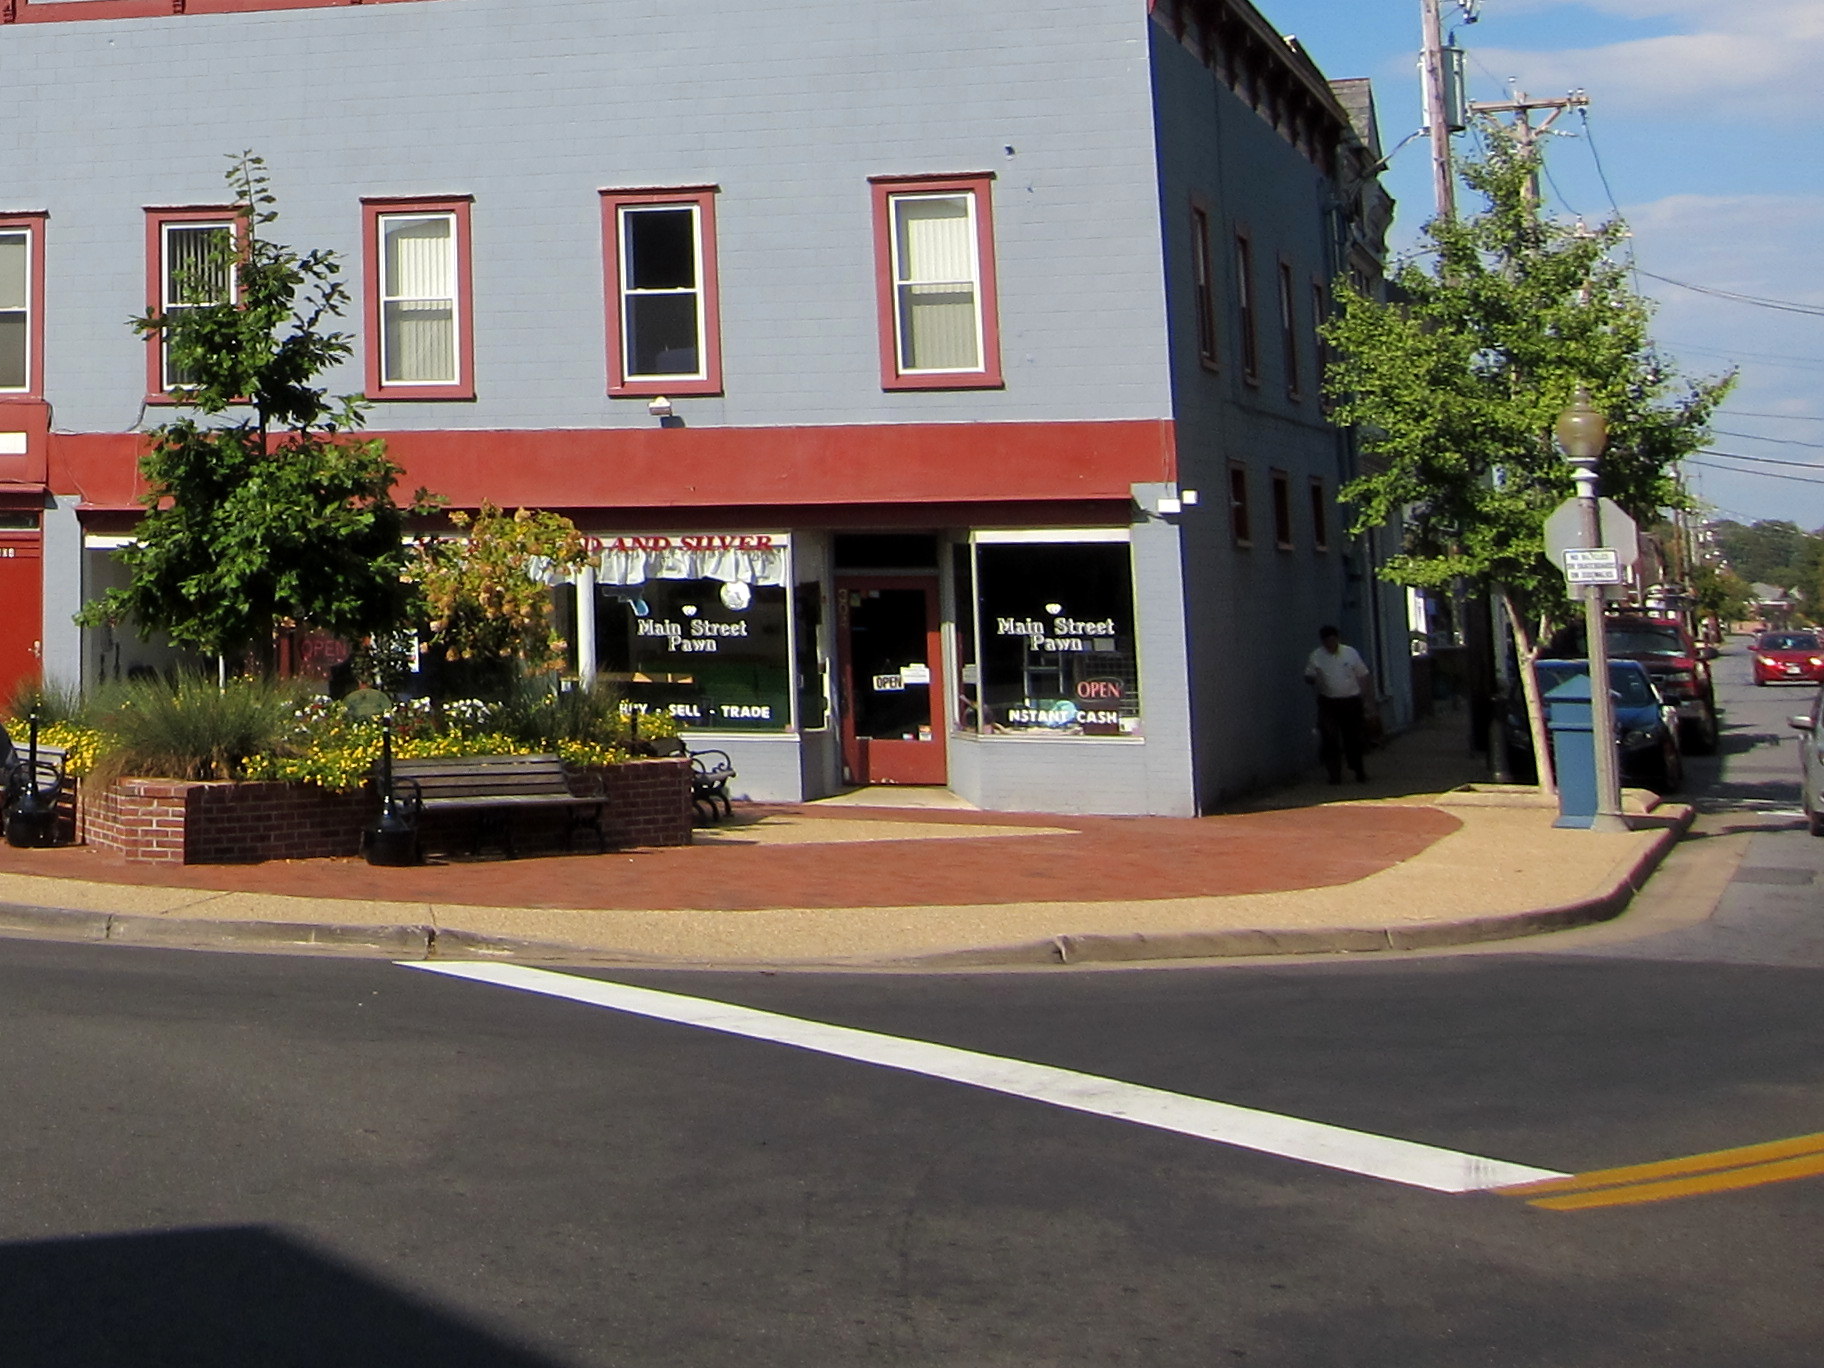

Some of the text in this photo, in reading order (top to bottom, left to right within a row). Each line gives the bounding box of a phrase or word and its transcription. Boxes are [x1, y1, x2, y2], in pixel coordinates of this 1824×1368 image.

[609, 536, 671, 551] AND
[679, 535, 773, 551] SILVER
[637, 619, 747, 636] Main Street
[997, 617, 1115, 635] Main Street
[301, 640, 347, 660] OPEN
[668, 635, 717, 652] Pawn
[1030, 635, 1083, 651] Pawn
[877, 676, 902, 689] OPEN
[1077, 681, 1120, 698] OPEN
[668, 704, 701, 717] SELL
[721, 705, 771, 719] TRADE
[1077, 710, 1117, 724] CASH
